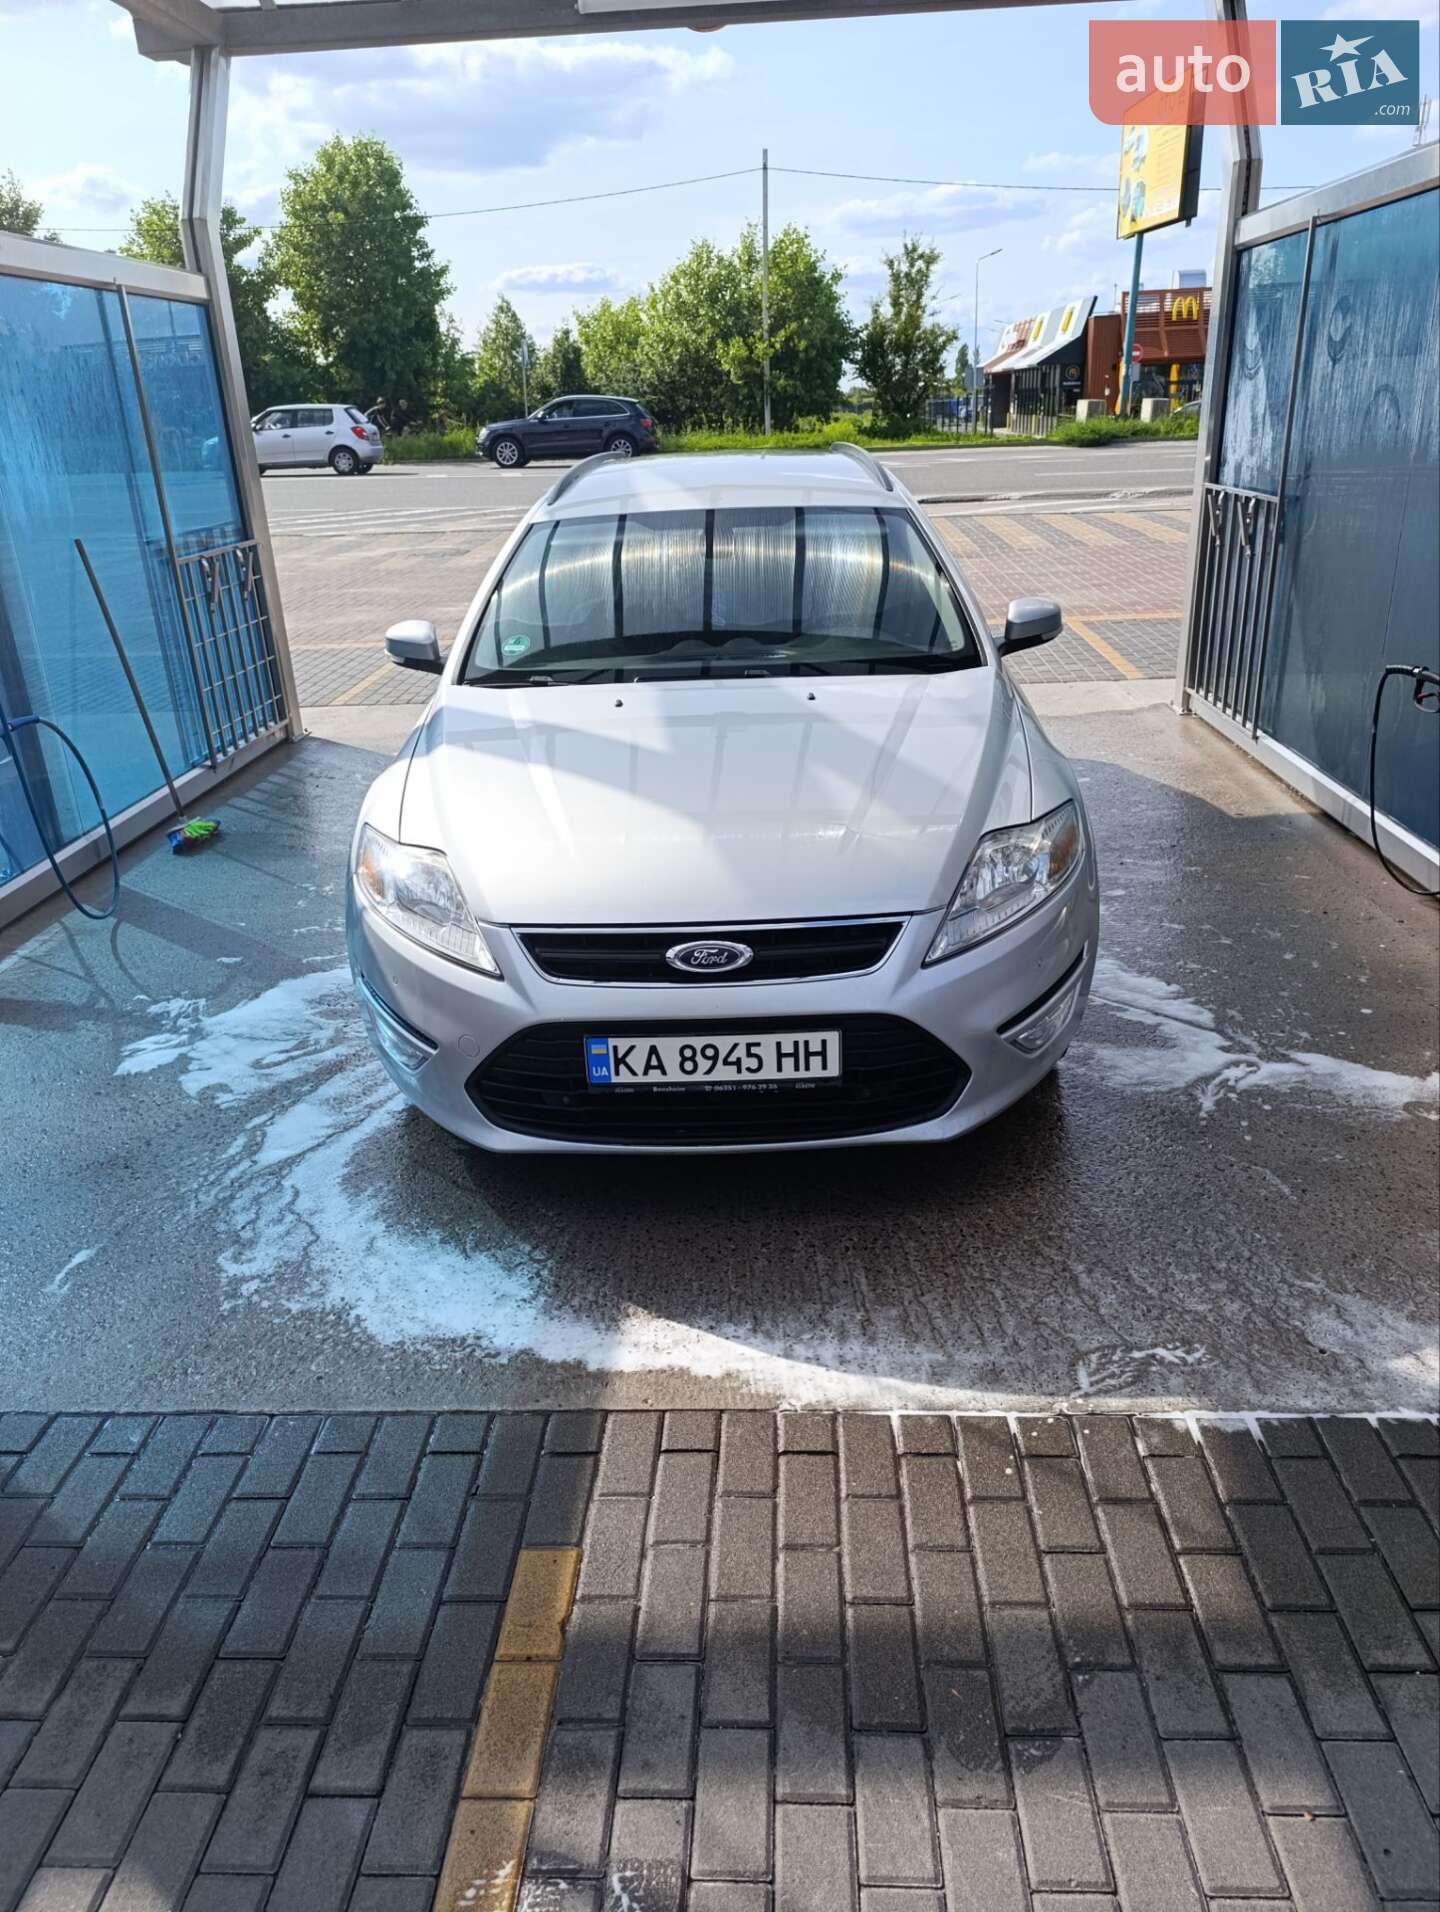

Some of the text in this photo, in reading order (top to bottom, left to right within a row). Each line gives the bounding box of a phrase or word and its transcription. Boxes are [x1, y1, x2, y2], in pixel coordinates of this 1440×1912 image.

[690, 949, 728, 965] Ford
[612, 1038, 828, 1077] KA 8945 HH
[593, 1067, 609, 1077] UA
